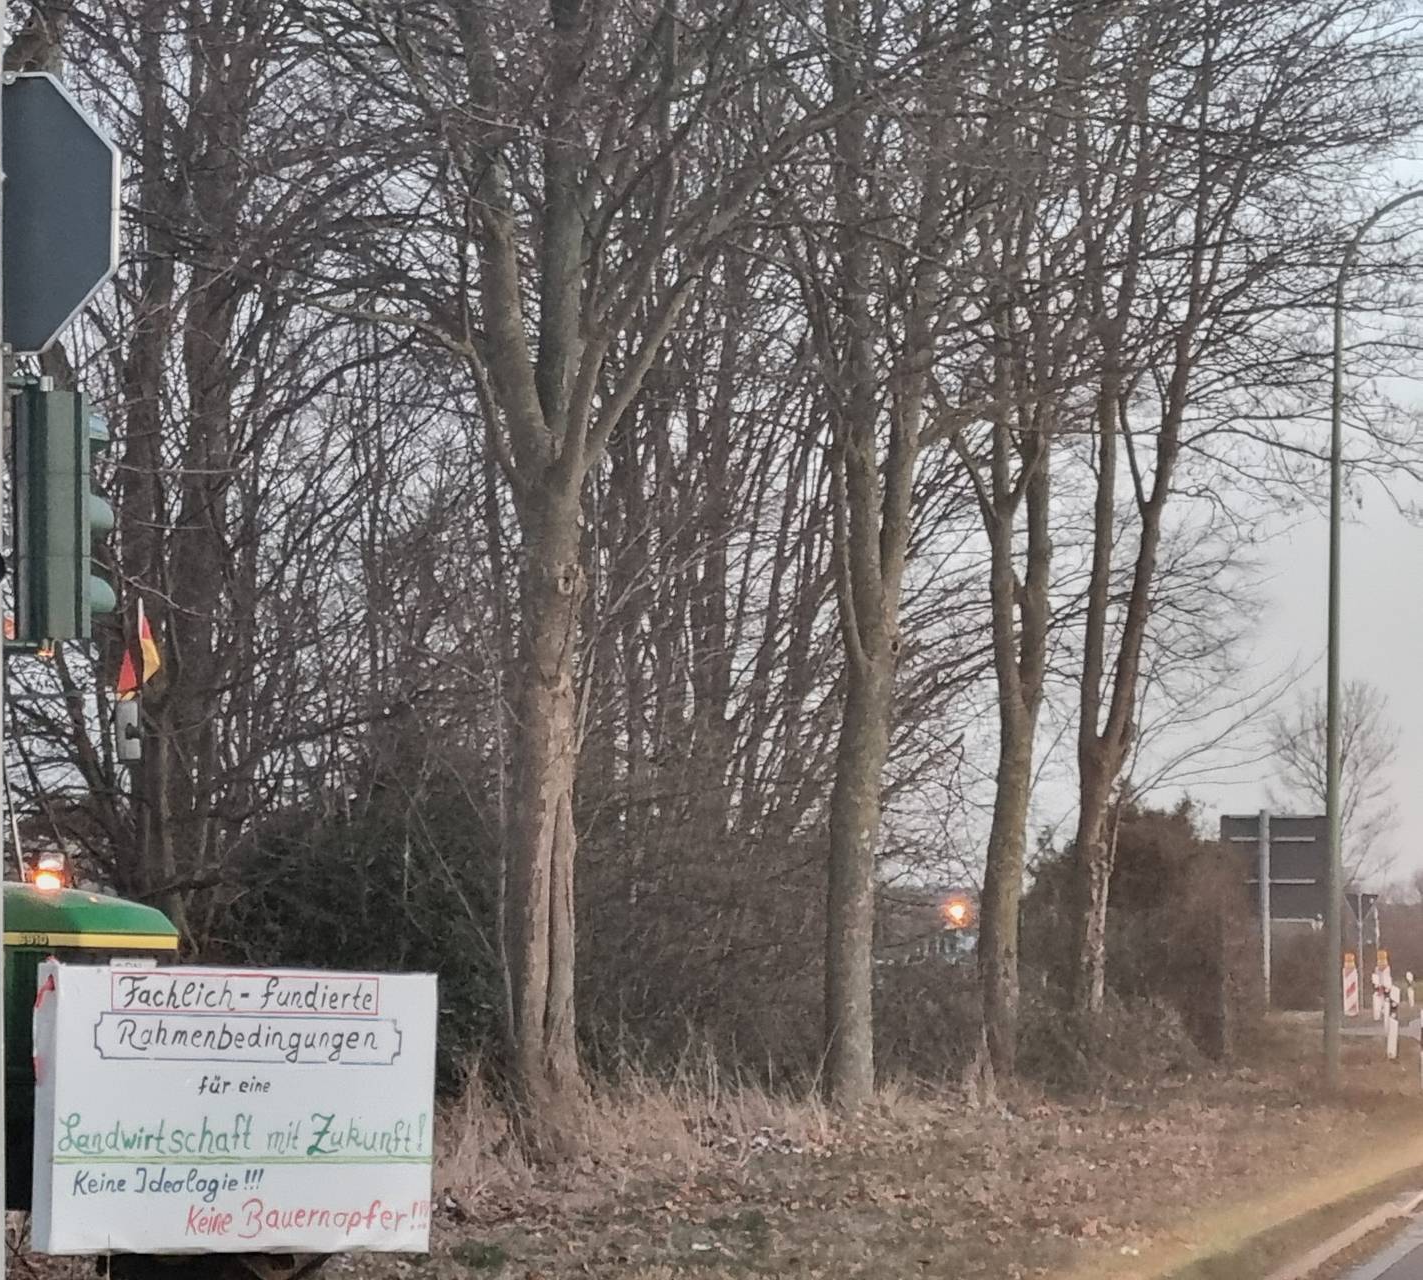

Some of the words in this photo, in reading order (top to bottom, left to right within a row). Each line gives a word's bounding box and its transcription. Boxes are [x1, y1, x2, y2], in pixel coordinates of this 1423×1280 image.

[117, 1019, 378, 1063] Rahmenbedingungen
[198, 1075, 232, 1095] für
[238, 1077, 272, 1095] eine
[58, 1112, 256, 1154] Landwirtschaft
[267, 1121, 301, 1153] mit
[306, 1112, 428, 1157] Zukunft!
[73, 1168, 127, 1196] Keine
[185, 1206, 234, 1237] Keine
